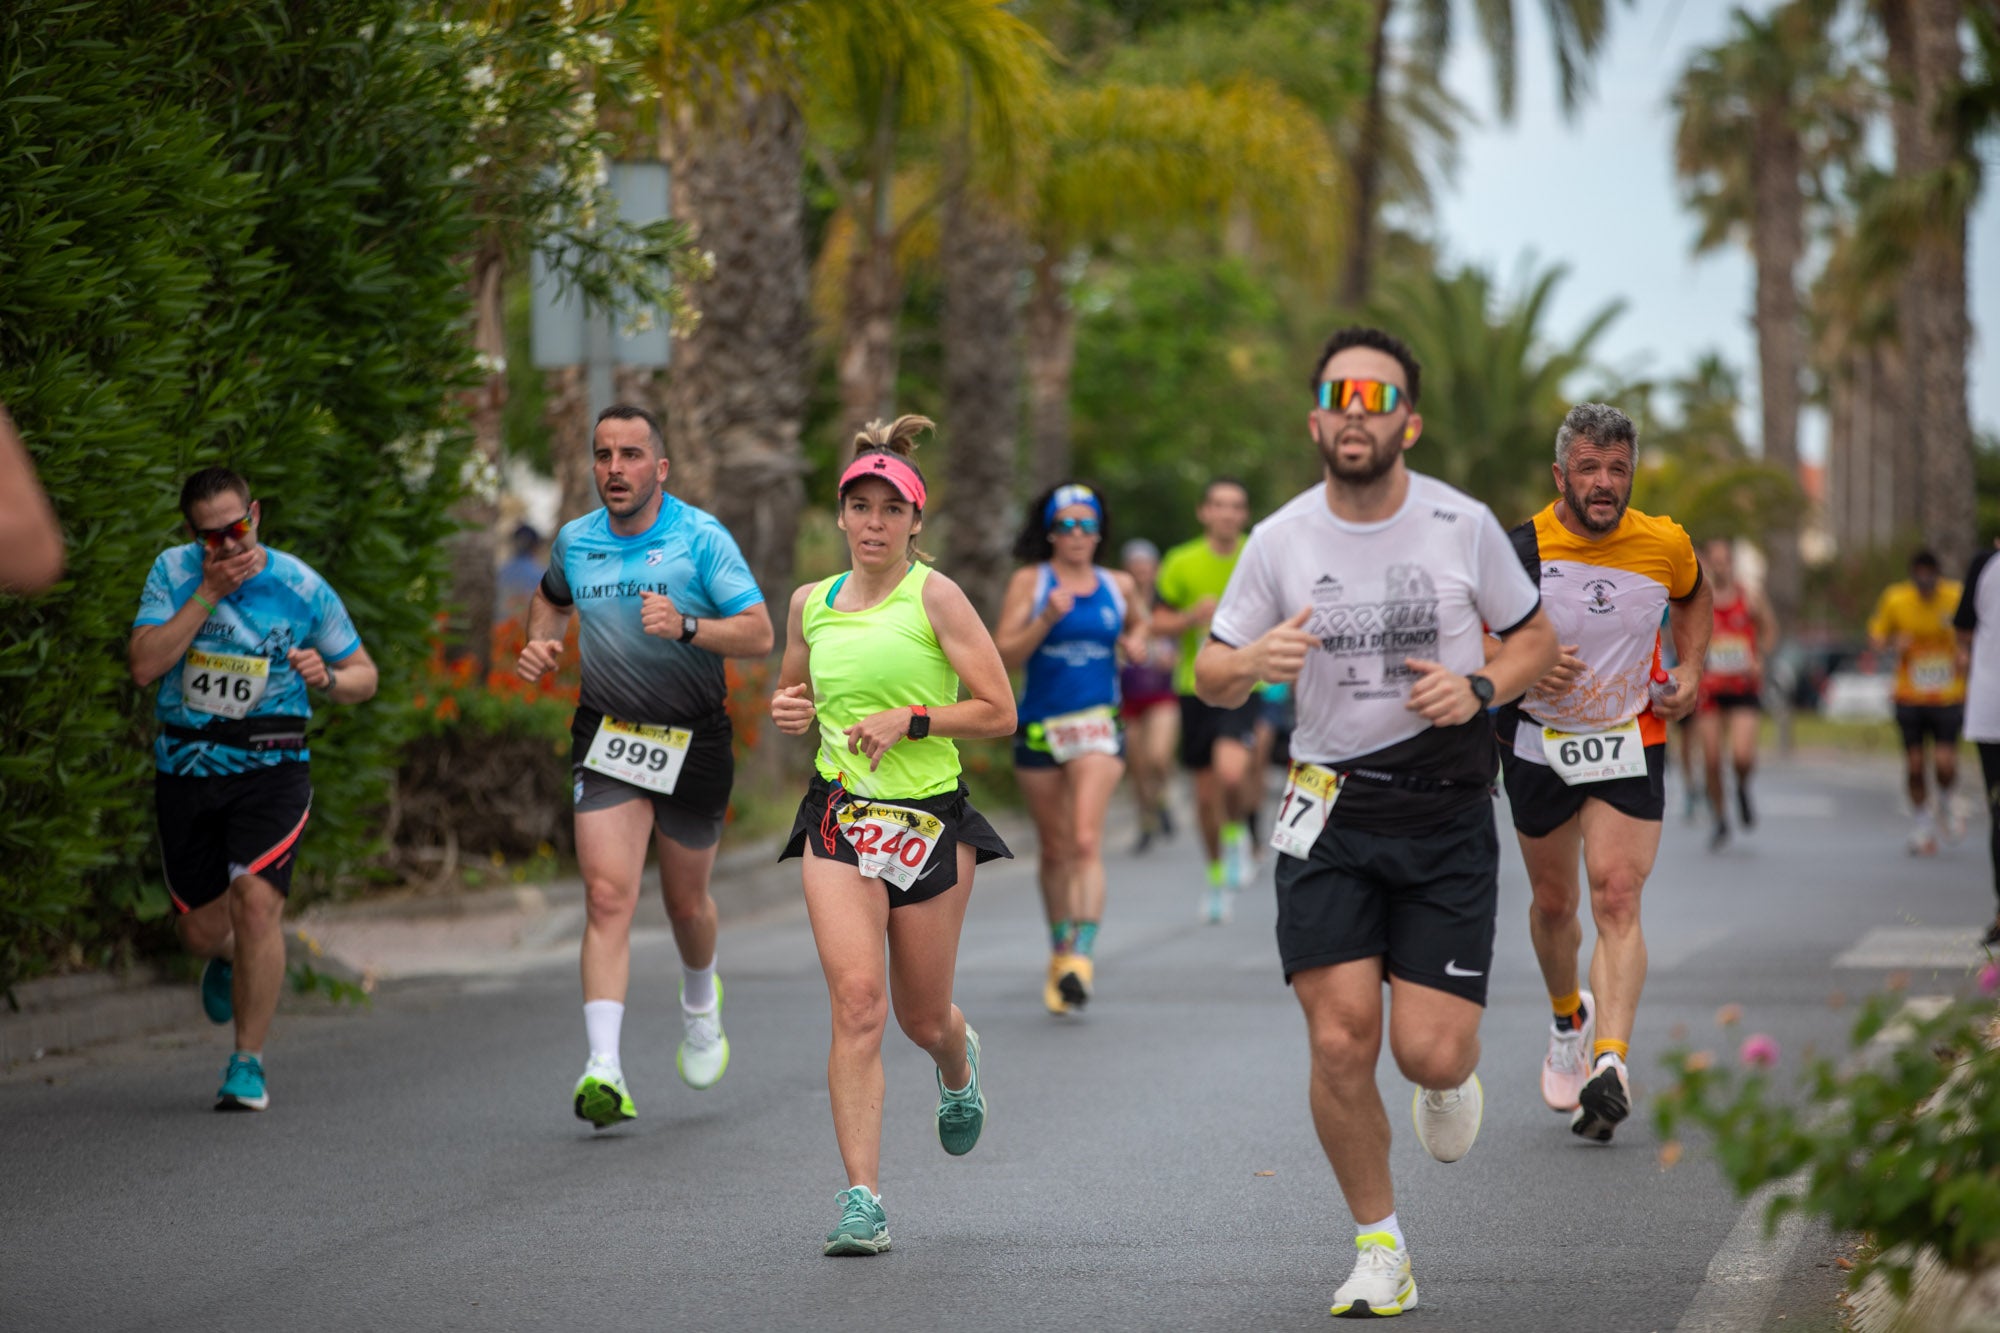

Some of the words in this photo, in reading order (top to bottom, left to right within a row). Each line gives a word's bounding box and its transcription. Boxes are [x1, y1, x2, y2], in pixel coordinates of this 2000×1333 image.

[1391, 628, 1438, 647] FONDO
[191, 673, 253, 702] 416
[605, 738, 668, 772] 999
[1560, 736, 1625, 767] 607
[847, 824, 927, 868] 2240
